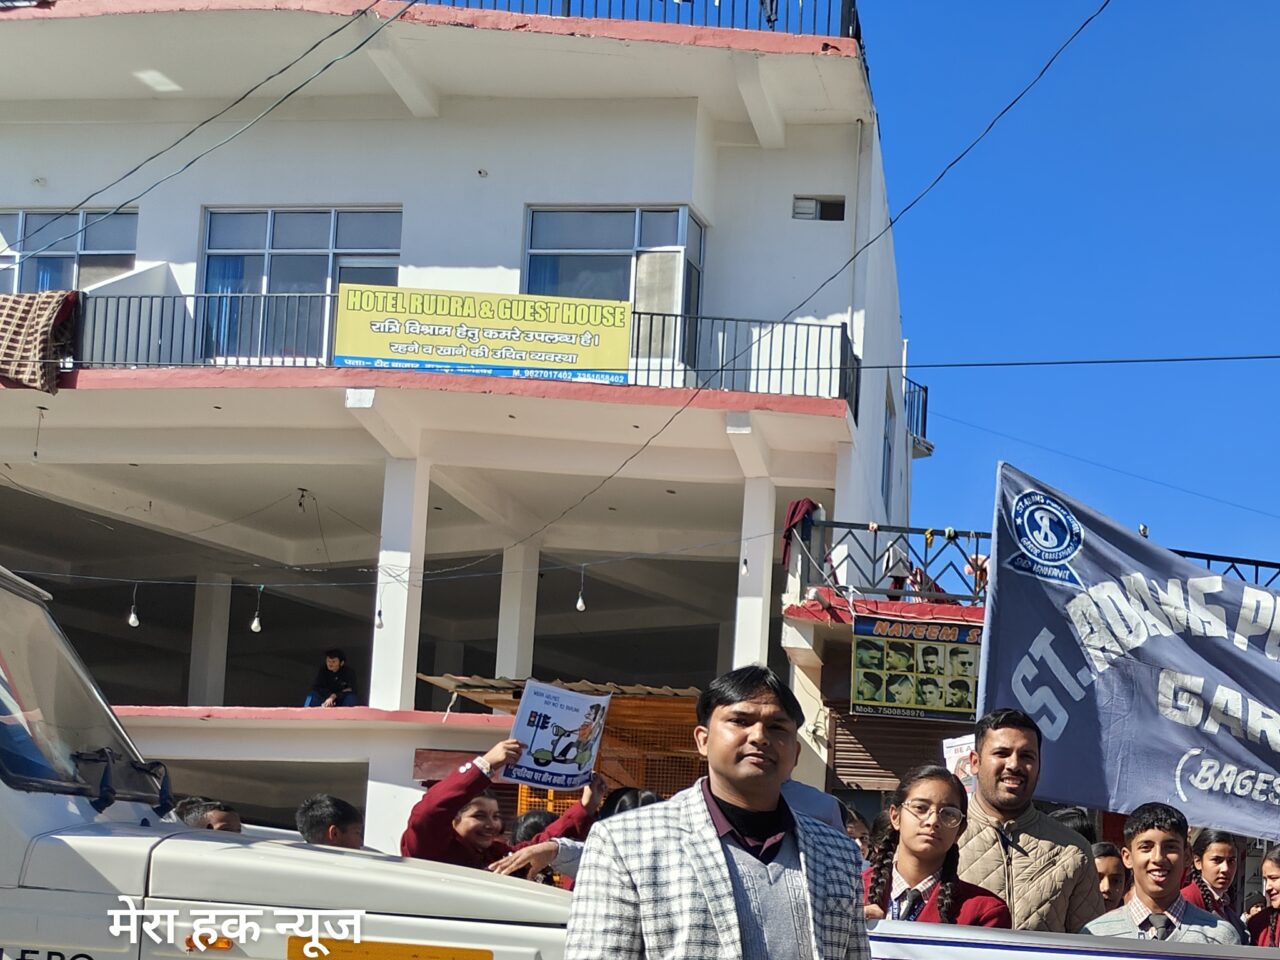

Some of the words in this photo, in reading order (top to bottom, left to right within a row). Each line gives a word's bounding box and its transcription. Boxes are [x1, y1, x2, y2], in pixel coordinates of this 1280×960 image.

[347, 289, 406, 313] HOTEL
[409, 293, 476, 317] RUDRA
[479, 300, 494, 319] &
[498, 299, 559, 323] GUEST
[562, 303, 625, 328] HOUSE
[370, 318, 401, 334] रात्रि
[405, 319, 452, 337] विश्राम
[455, 323, 479, 343] हेतु
[483, 327, 521, 341] कमरे
[389, 341, 420, 355] रहने
[422, 344, 434, 355] व
[436, 344, 467, 358] खाने
[469, 344, 489, 358] की
[492, 347, 527, 362] उचित
[873, 621, 958, 641] NAYEEM
[966, 628, 980, 642] S
[856, 704, 876, 714] Mob.
